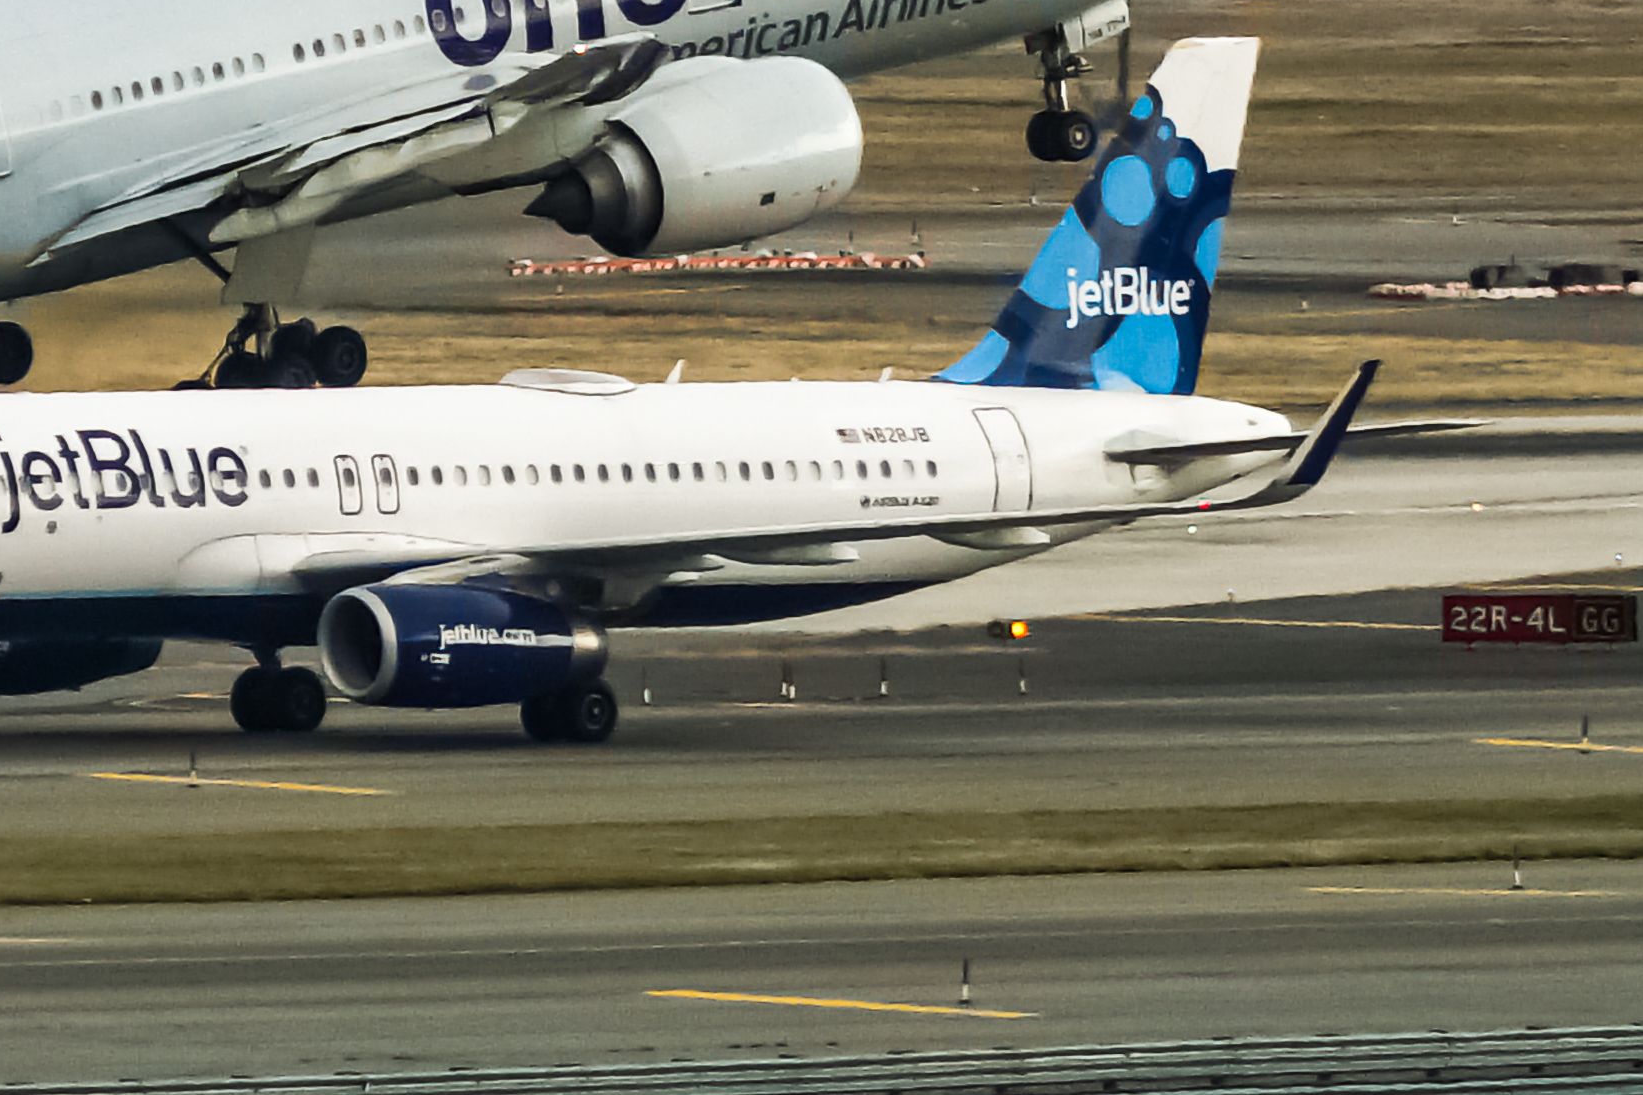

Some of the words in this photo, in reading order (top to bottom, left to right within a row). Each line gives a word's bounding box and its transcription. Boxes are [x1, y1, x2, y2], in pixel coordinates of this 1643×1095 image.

[671, 11, 829, 62] erican
[1066, 266, 1190, 329] jetBlue
[1450, 606, 1566, 633] 22R-4L
[1582, 607, 1619, 633] GG
